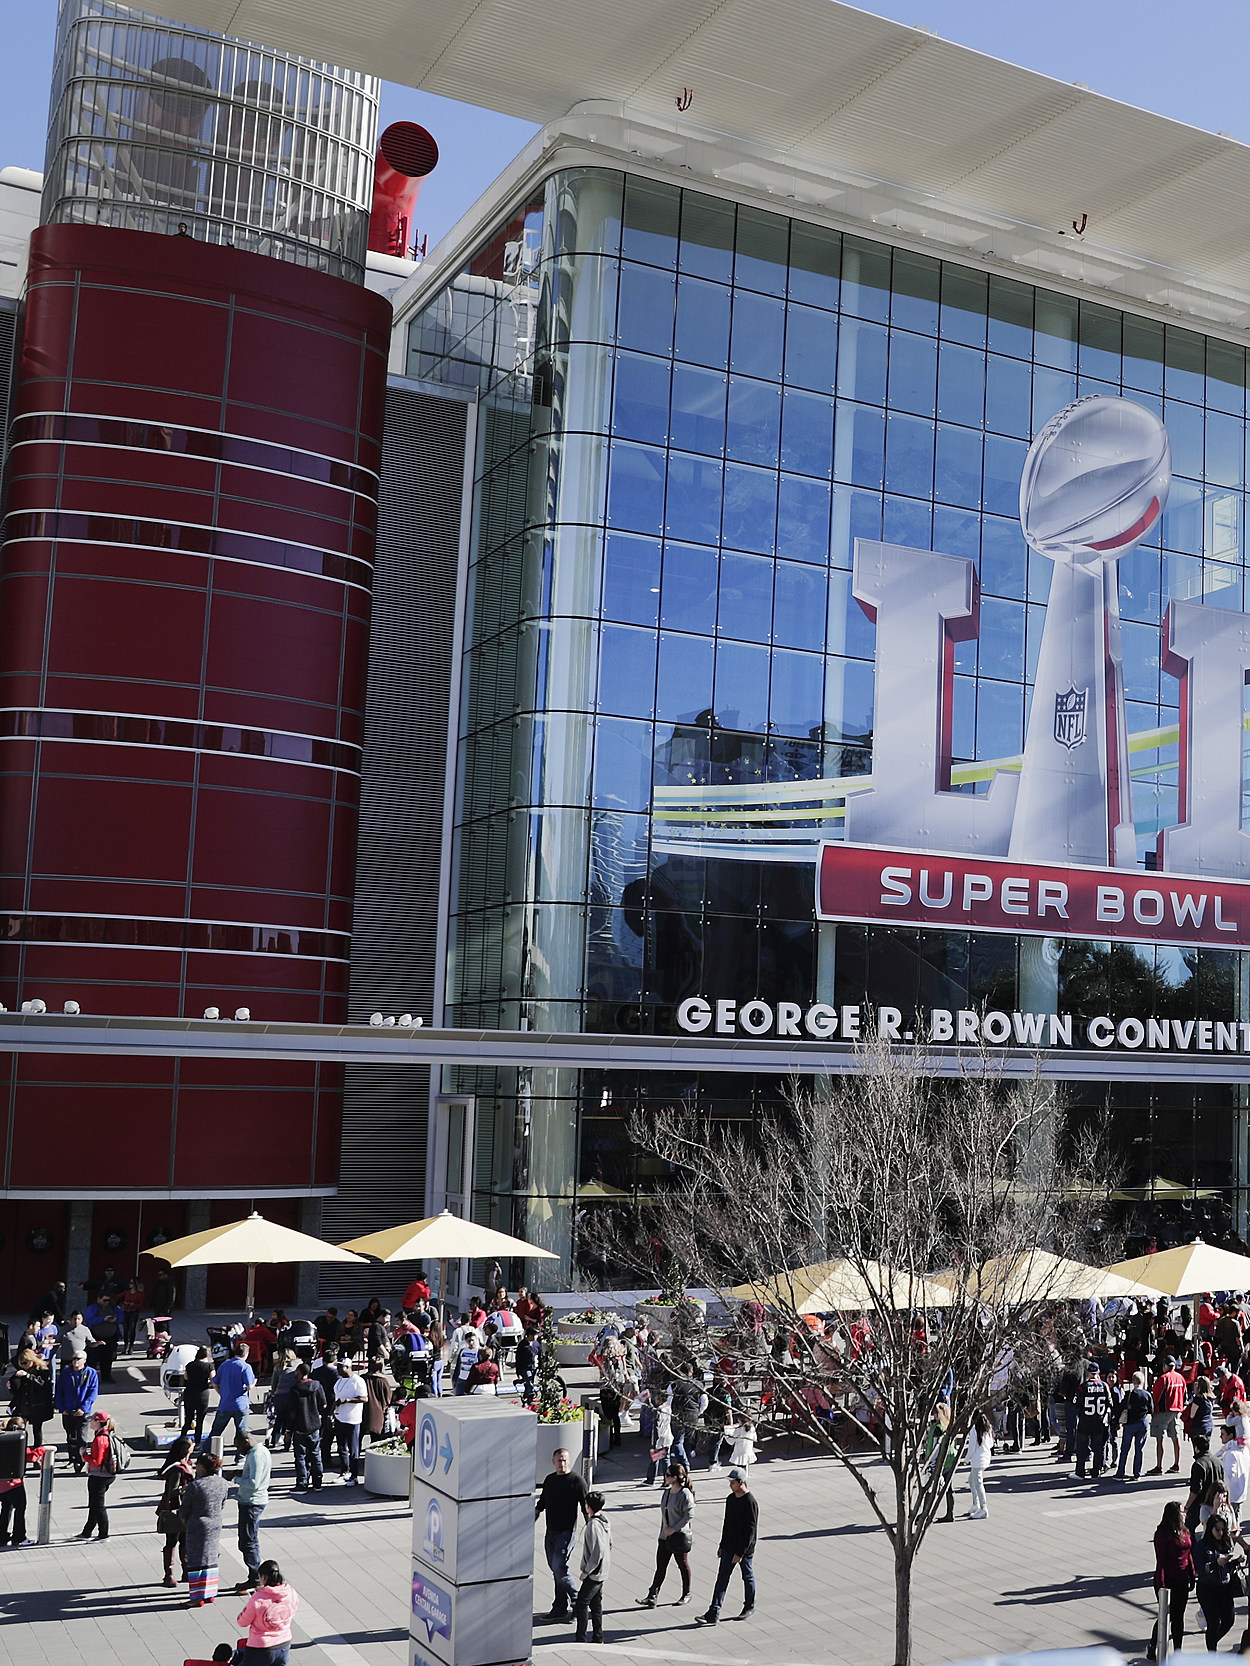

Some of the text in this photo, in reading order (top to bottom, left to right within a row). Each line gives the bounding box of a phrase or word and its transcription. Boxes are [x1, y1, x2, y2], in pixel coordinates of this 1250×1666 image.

[1057, 714, 1081, 742] NFL
[880, 866, 1238, 932] SUPER BOWL
[676, 997, 860, 1038] GEORGE
[877, 1006, 914, 1041] R.
[930, 1009, 1073, 1045] BROWN
[1084, 1396, 1106, 1416] 56
[423, 1429, 432, 1460] P
[430, 1511, 439, 1543] P
